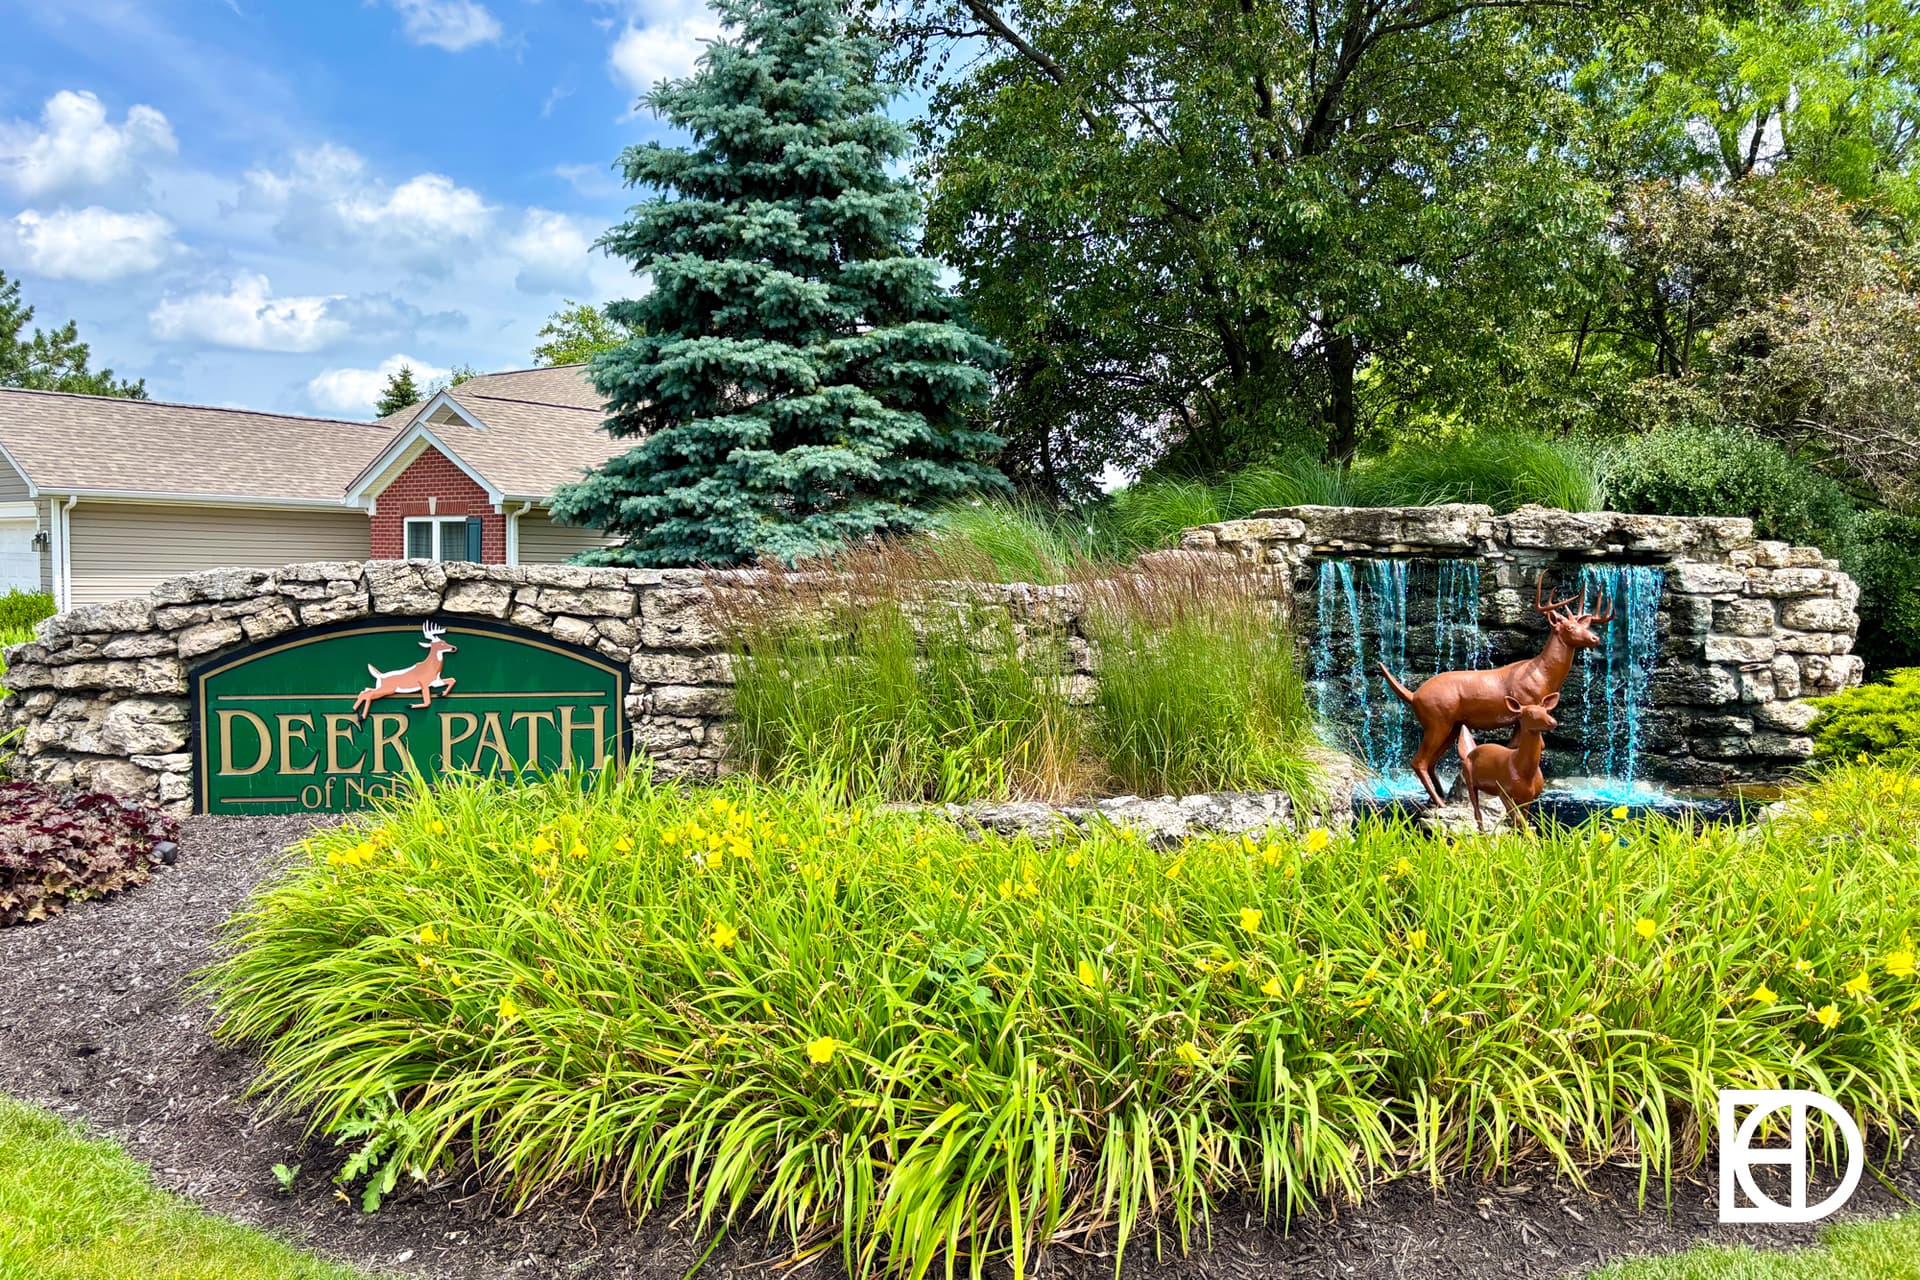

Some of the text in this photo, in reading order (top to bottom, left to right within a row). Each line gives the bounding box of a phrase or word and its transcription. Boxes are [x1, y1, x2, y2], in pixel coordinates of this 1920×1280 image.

[215, 705, 609, 776] DEER PATH
[301, 776, 336, 809] of
